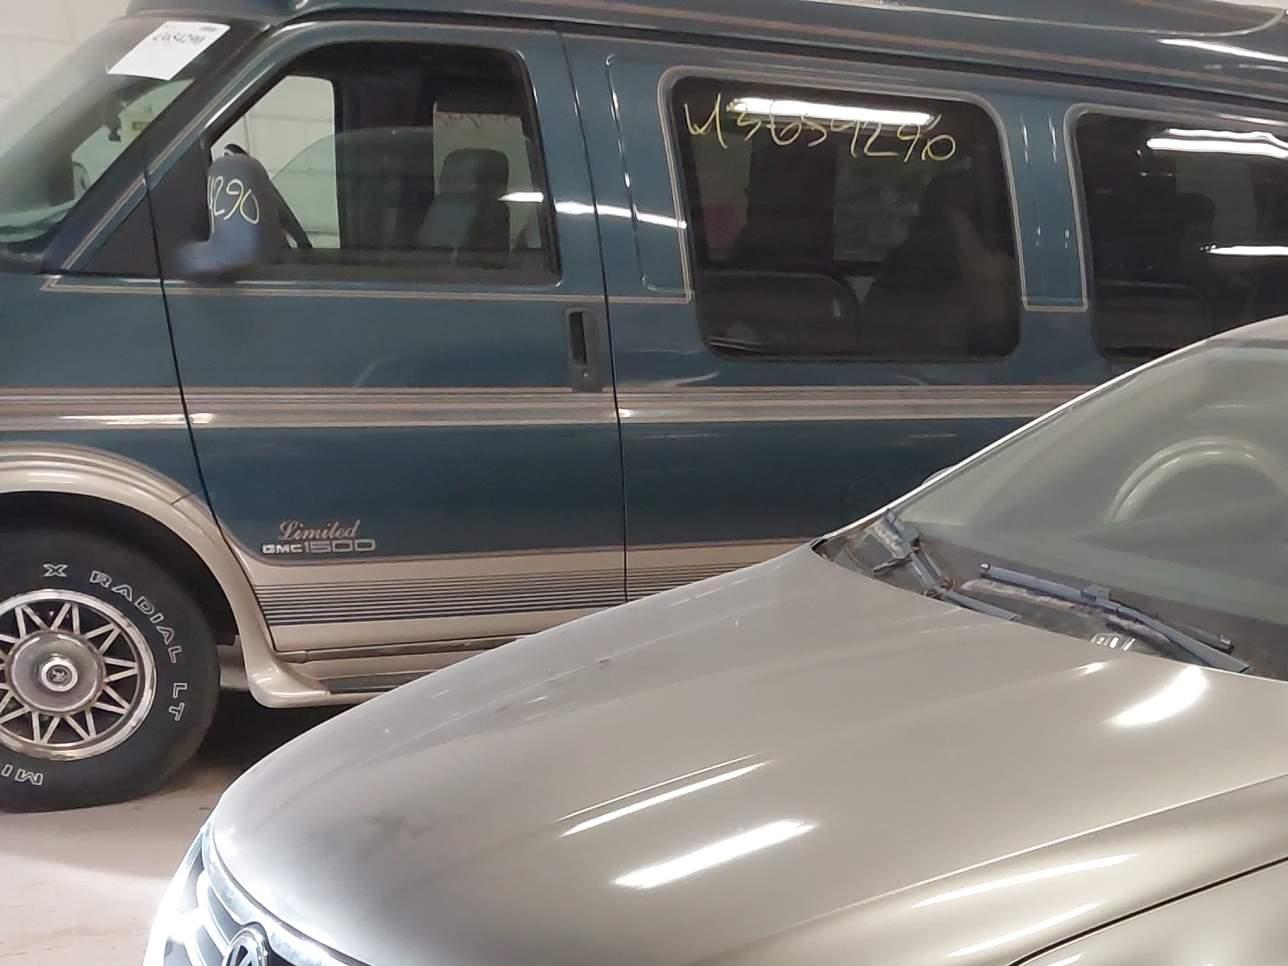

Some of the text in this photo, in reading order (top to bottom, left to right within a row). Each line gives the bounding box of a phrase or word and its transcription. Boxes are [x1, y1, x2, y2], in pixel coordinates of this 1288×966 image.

[278, 519, 361, 541] Limited
[42, 563, 188, 722] X RADIAL LT
